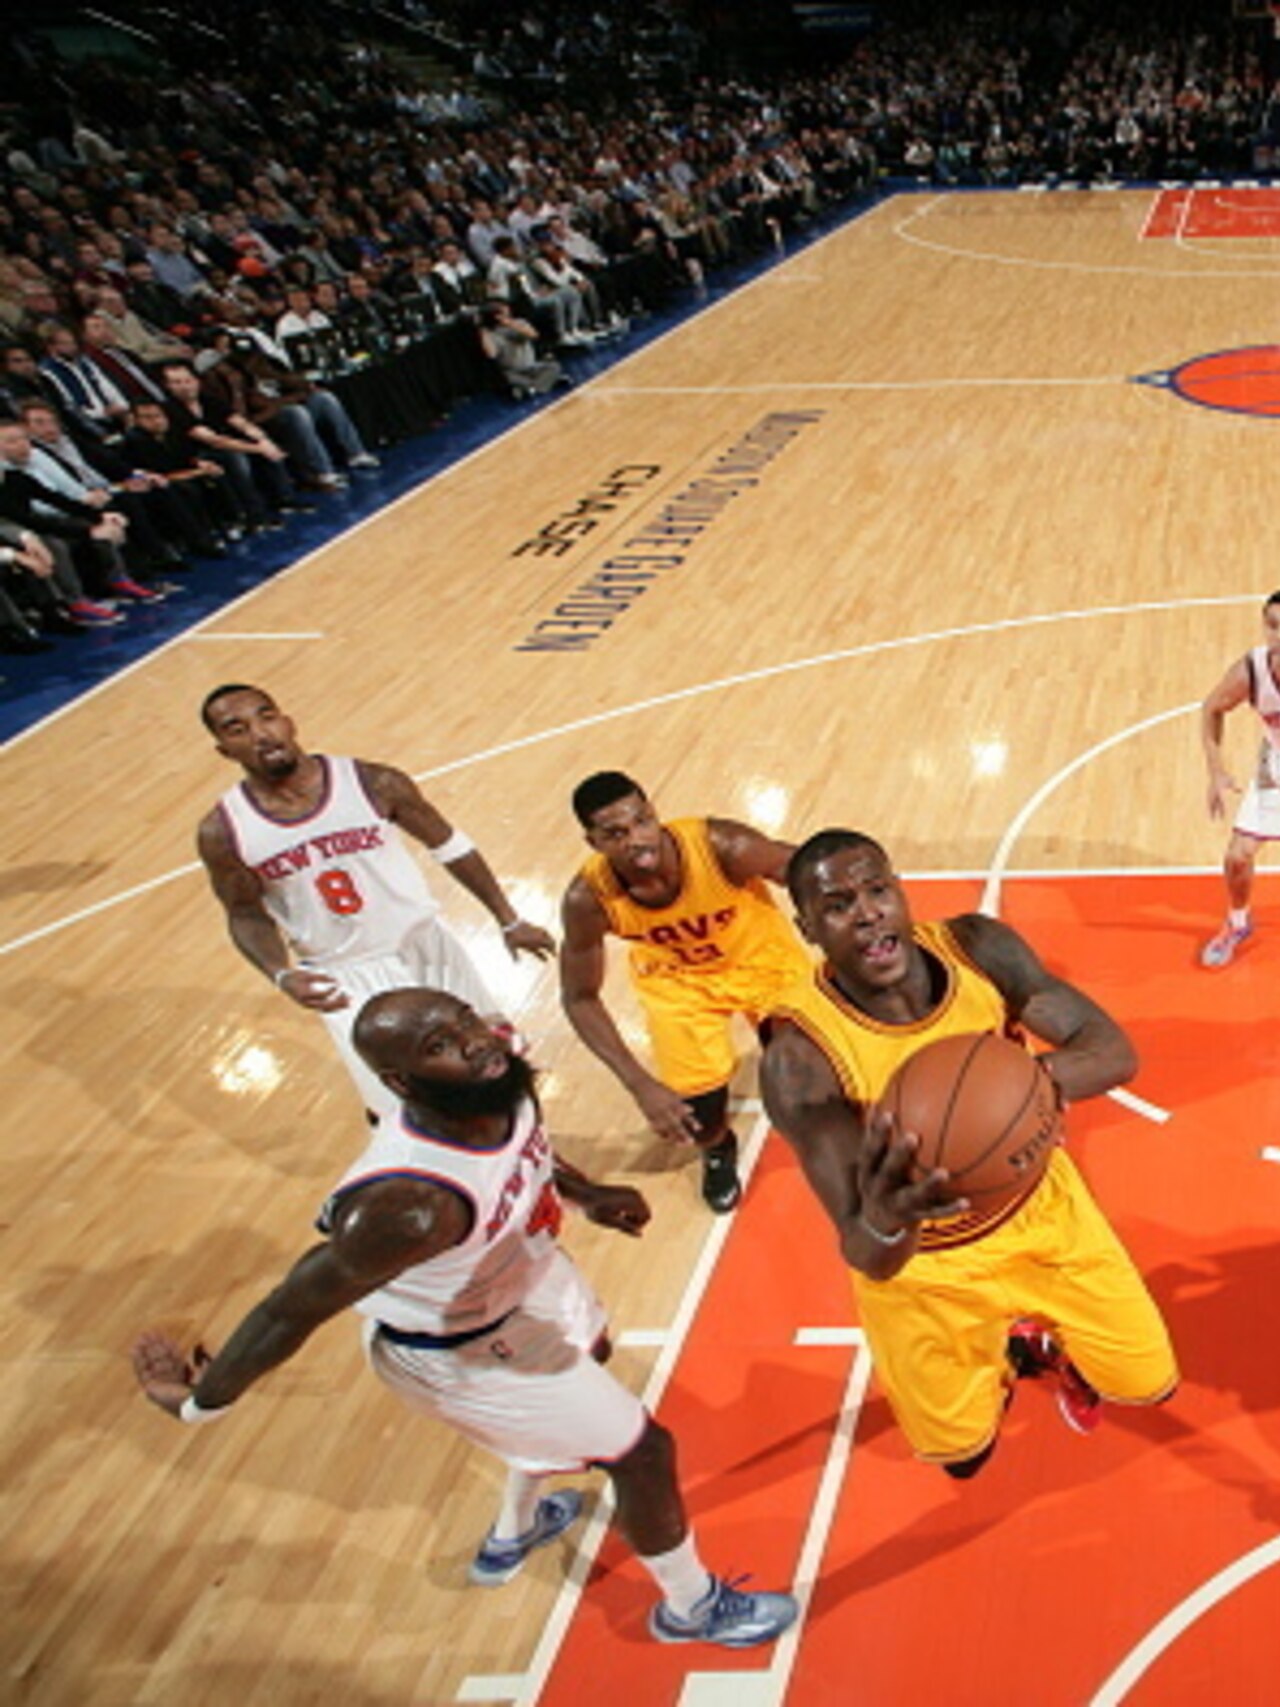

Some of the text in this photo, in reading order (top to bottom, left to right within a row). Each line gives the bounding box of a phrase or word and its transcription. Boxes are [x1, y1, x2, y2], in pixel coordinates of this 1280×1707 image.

[511, 464, 661, 558] CHASE
[512, 555, 686, 652] GARDEN
[309, 825, 384, 859] YORK
[314, 868, 364, 915] 8
